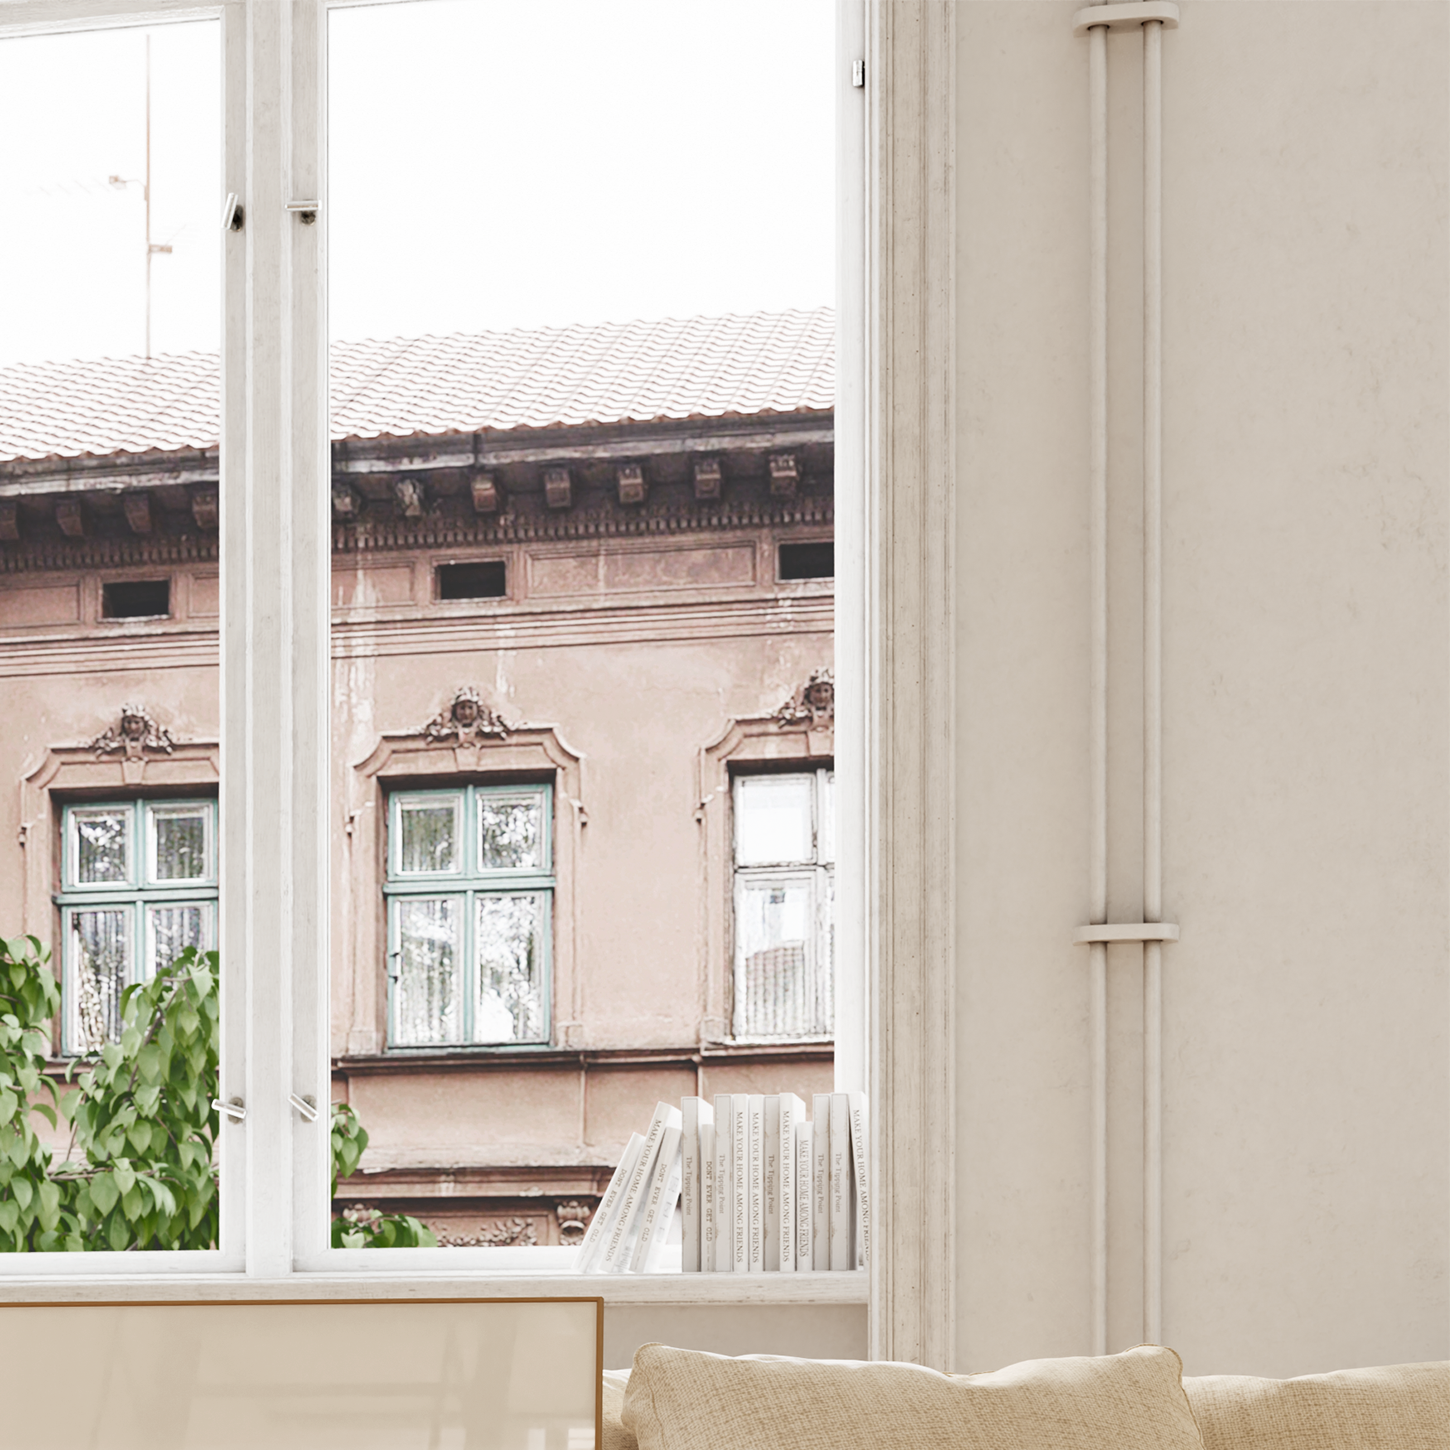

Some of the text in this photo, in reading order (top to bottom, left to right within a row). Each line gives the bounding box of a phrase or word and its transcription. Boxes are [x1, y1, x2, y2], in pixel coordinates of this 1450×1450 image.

[855, 1136, 864, 1160] YOUR
[685, 1171, 693, 1197] Tipping
[718, 1169, 726, 1195] Tipping
[736, 1111, 744, 1263] MAKE YOUR HOME AMONG FRIENDS
[767, 1169, 775, 1195] Tipping
[782, 1110, 790, 1263] MAKE YOUR HOME AMONG FRIENDS
[817, 1169, 825, 1195] Tipping
[834, 1167, 842, 1194] Tipping
[857, 1161, 866, 1188] HOME
[605, 1119, 661, 1262] MAKE YOUR HOME AMONG FRIENDS
[605, 1190, 617, 1208] EVER
[649, 1186, 661, 1206] EVER
[799, 1139, 809, 1257] MAKE YOUR HOME AMONG FRIENDS
[599, 1212, 607, 1226] GET
[646, 1210, 655, 1224] GET
[860, 1189, 869, 1223] AMONG
[590, 1228, 600, 1243] OLD
[641, 1227, 650, 1242] OLD
